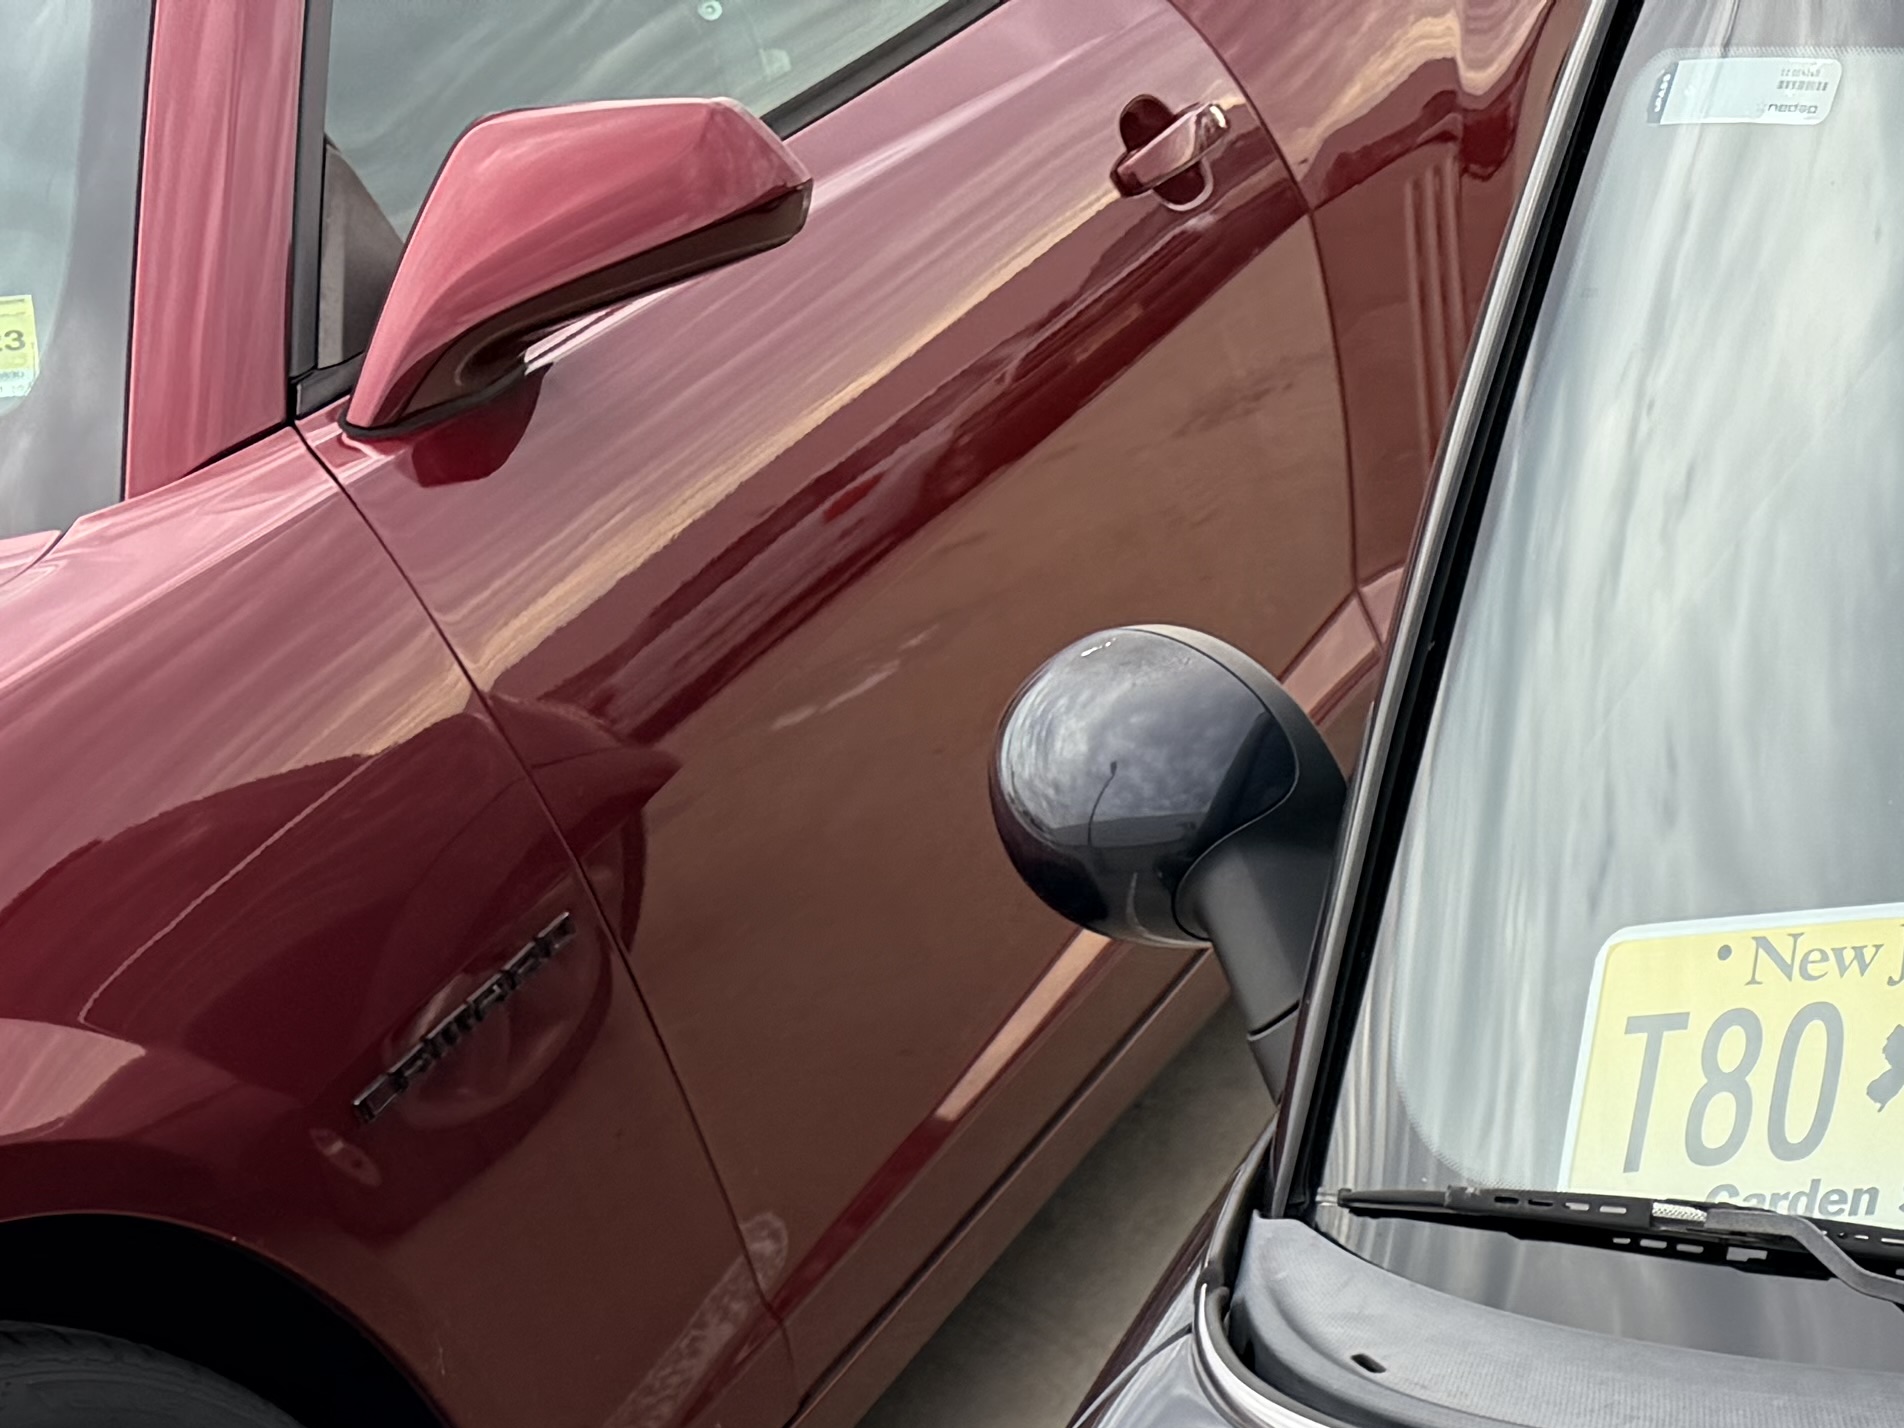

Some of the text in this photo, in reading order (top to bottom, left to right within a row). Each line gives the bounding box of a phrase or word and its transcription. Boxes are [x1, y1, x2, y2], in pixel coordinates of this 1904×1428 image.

[0, 329, 26, 351] 3
[1745, 932, 1884, 987] New
[1622, 1001, 1845, 1174] T80
